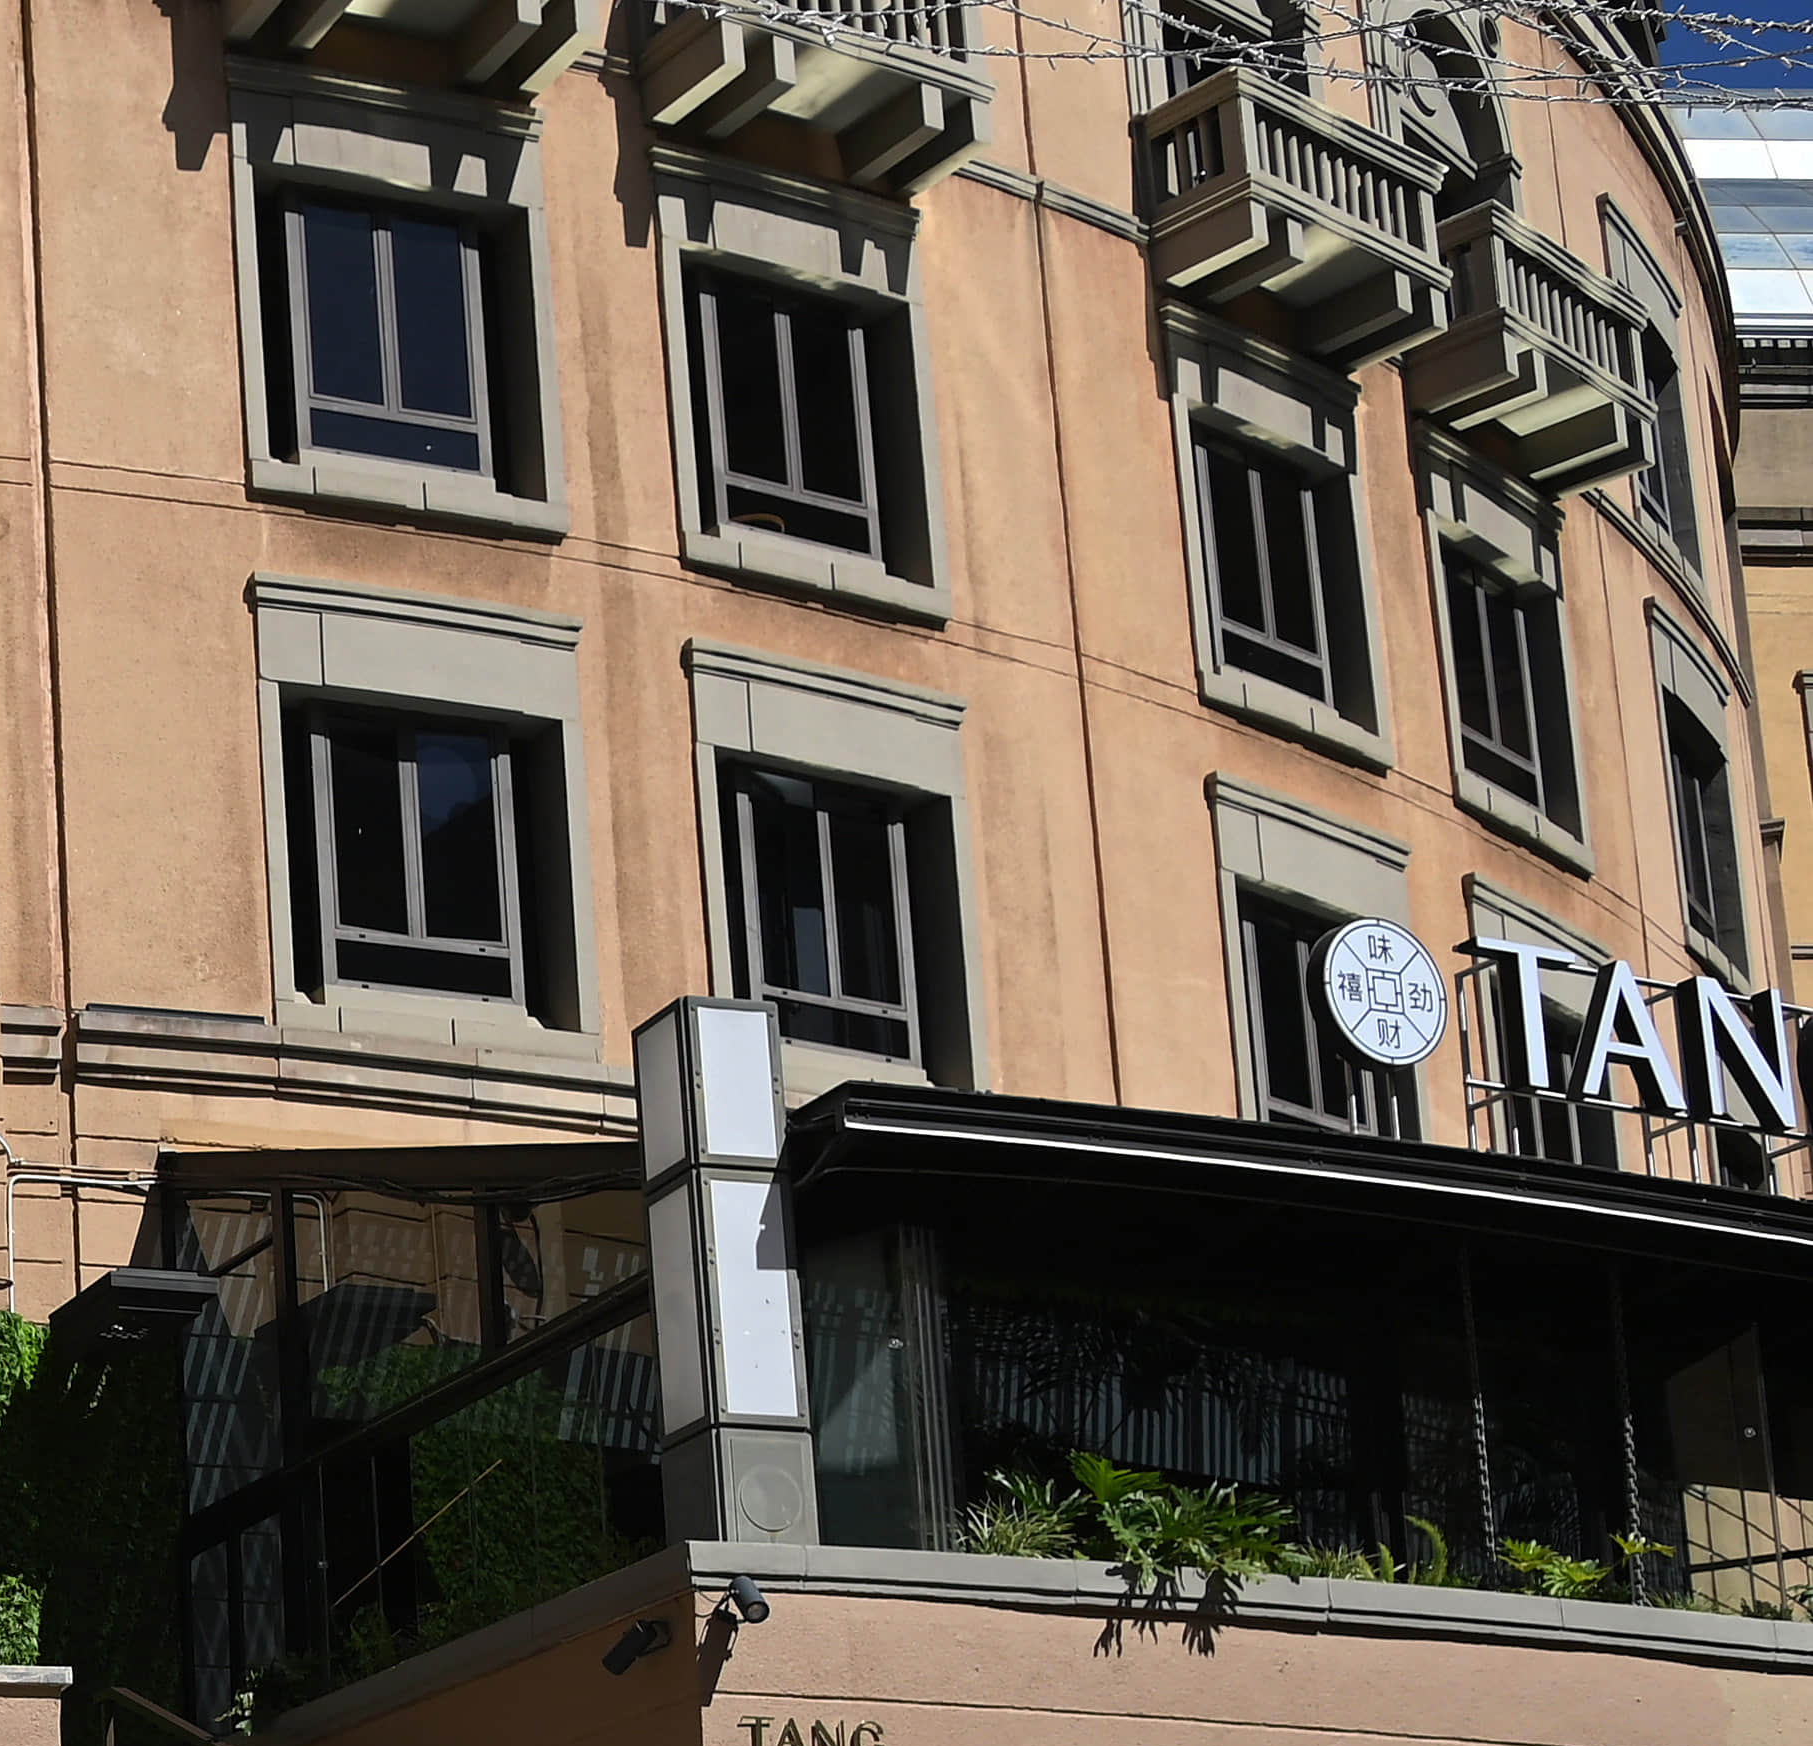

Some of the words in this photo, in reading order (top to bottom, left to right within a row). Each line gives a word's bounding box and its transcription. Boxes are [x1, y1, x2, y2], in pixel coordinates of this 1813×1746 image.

[1367, 934, 1393, 964] 味
[1338, 969, 1364, 1002] 禧
[1377, 1018, 1402, 1049] 财
[1473, 936, 1805, 1130] TAN
